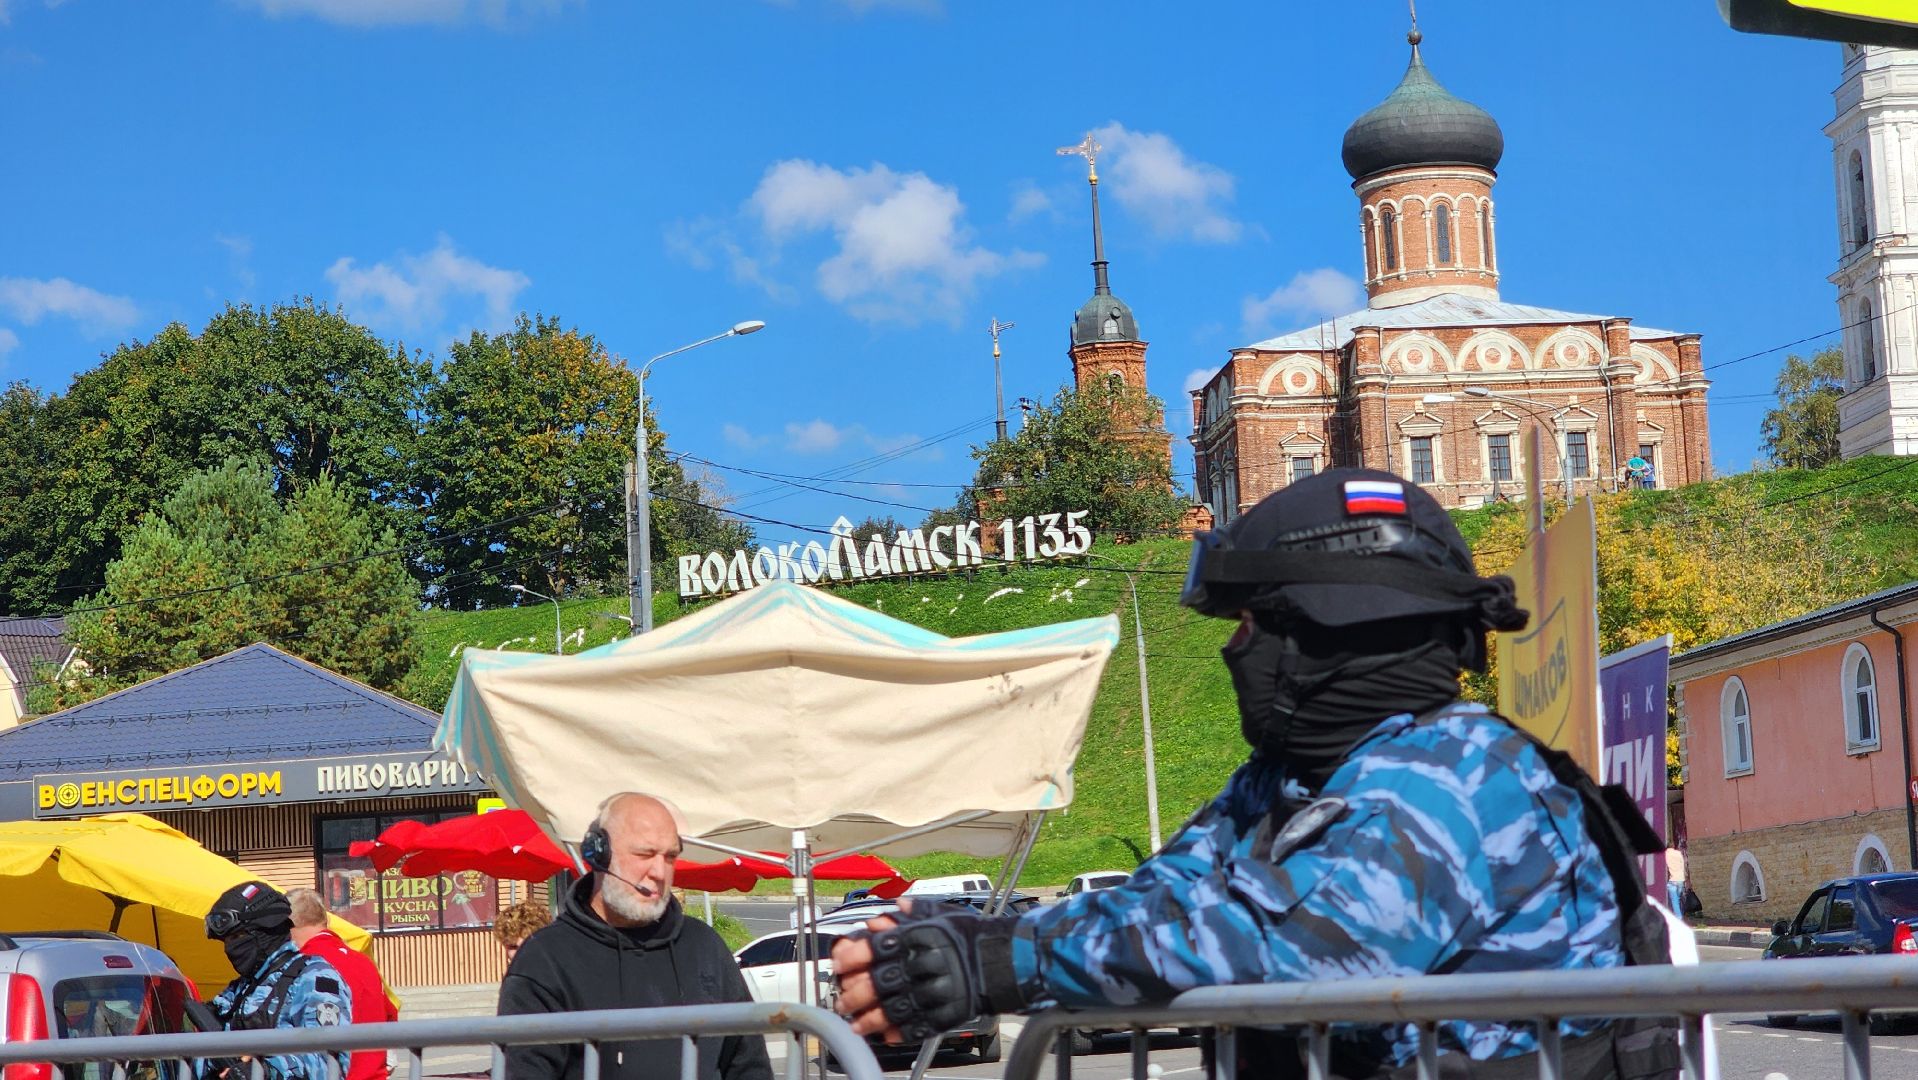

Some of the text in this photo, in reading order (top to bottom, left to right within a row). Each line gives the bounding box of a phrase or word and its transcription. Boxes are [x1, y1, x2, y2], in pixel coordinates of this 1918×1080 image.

[998, 510, 1091, 561] 1135
[1514, 636, 1567, 720] ШМАКОВ
[39, 771, 282, 809] ВОЕНСПЕЦФОРМ
[317, 760, 486, 793] ПИВОВАРИ
[367, 877, 453, 899] ПИВО
[391, 914, 430, 923] РЫБКА
